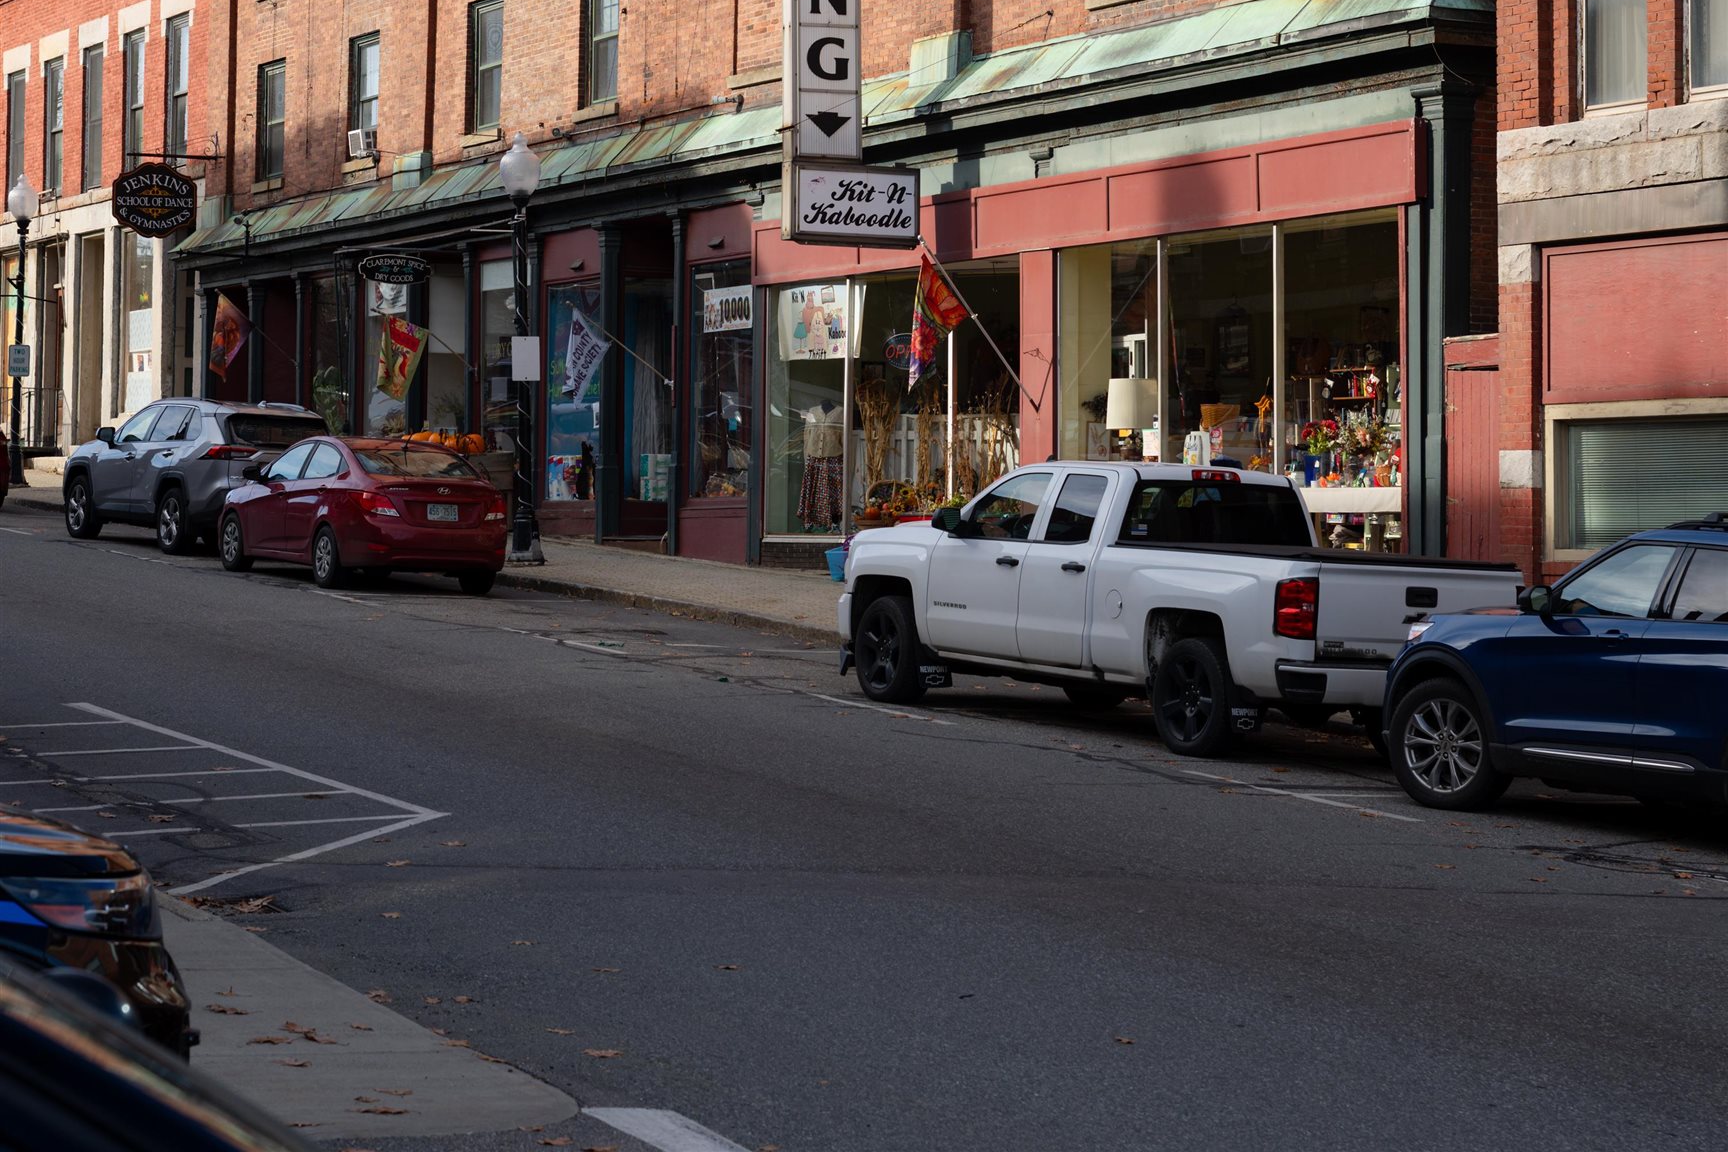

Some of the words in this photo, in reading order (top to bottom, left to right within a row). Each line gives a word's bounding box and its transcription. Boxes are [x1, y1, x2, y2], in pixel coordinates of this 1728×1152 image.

[123, 174, 189, 195] JENKINS
[116, 195, 151, 206] SCHOOL
[152, 197, 163, 206] OF
[165, 197, 193, 208] DANCE
[119, 207, 128, 217] &
[129, 209, 190, 228] GYMNASTICS
[803, 202, 912, 229] Kaboodle
[366, 258, 406, 268] CLAREMONT
[408, 260, 424, 270] SPICE
[374, 273, 389, 281] DRY
[573, 330, 593, 362] COUNTY
[581, 342, 603, 372] SOCIETY
